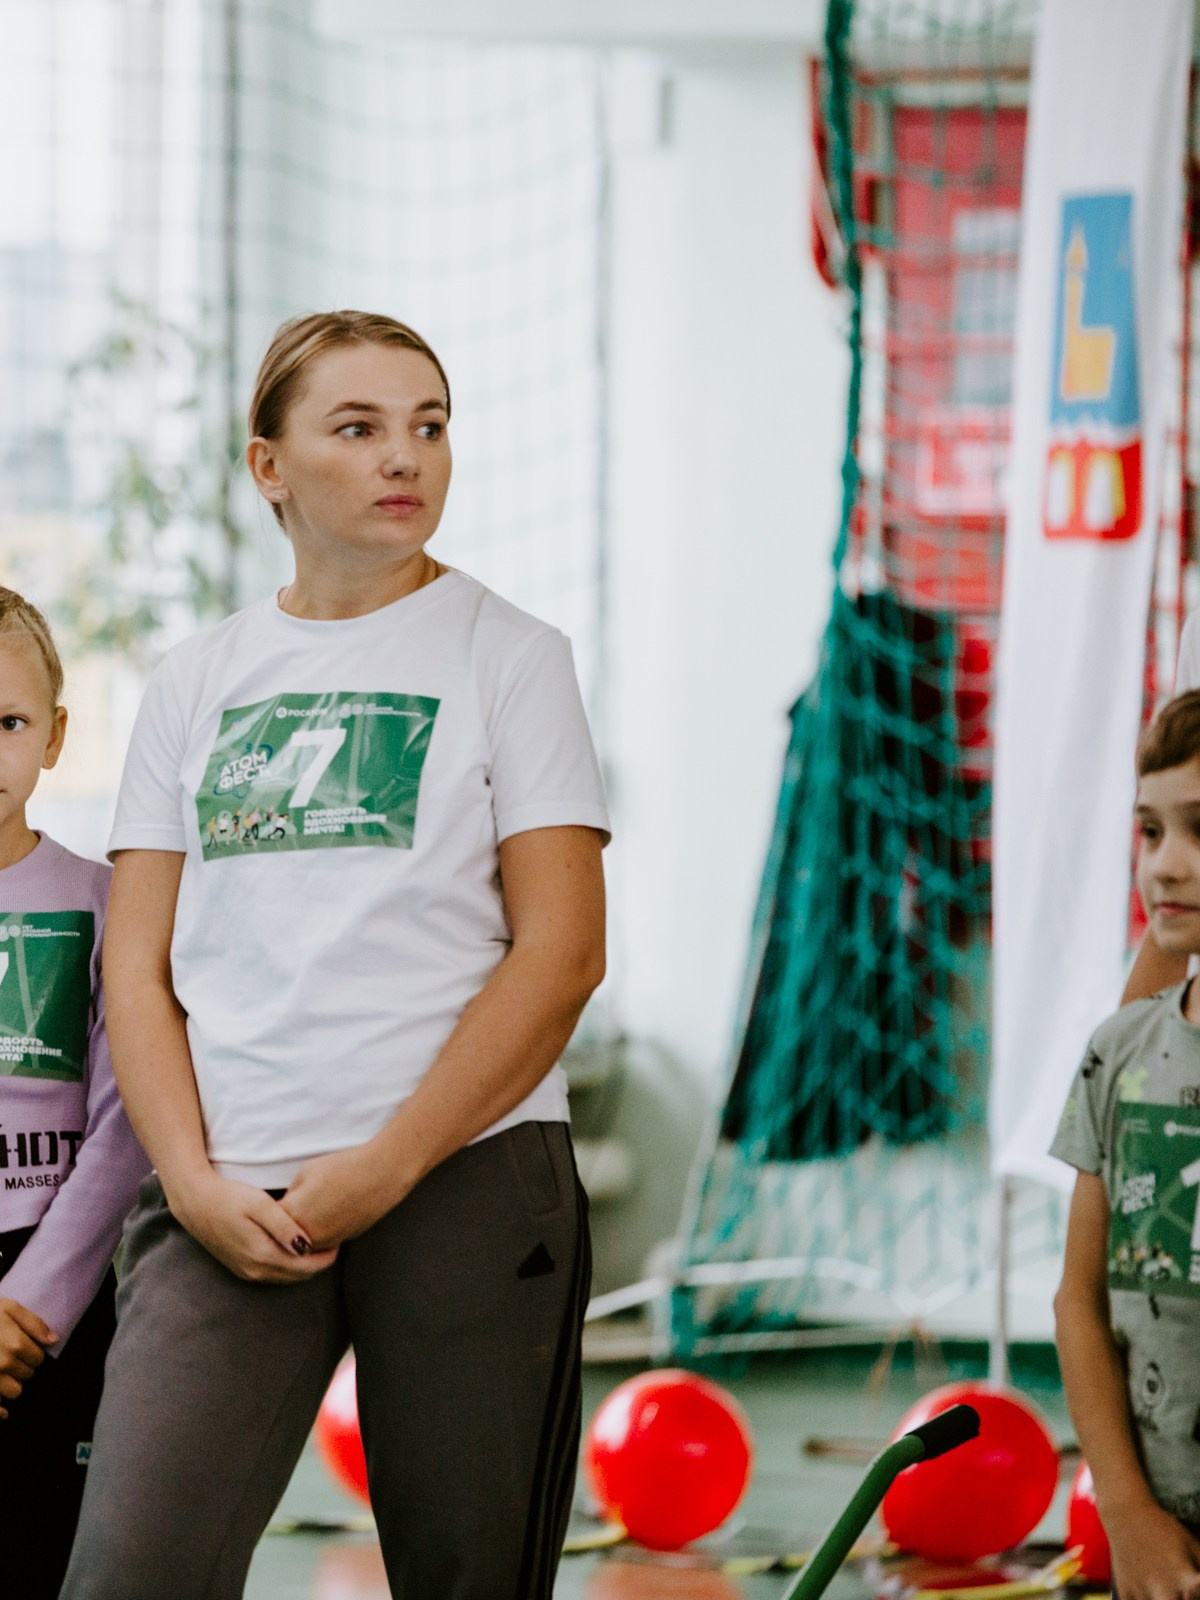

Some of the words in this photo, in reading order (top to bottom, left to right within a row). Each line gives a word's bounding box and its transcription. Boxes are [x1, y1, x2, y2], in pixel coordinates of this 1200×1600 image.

[218, 764, 269, 790] ФЕСТ
[220, 751, 267, 777] АТОМ
[289, 728, 347, 808] 7
[4, 1174, 60, 1190] MASSES
